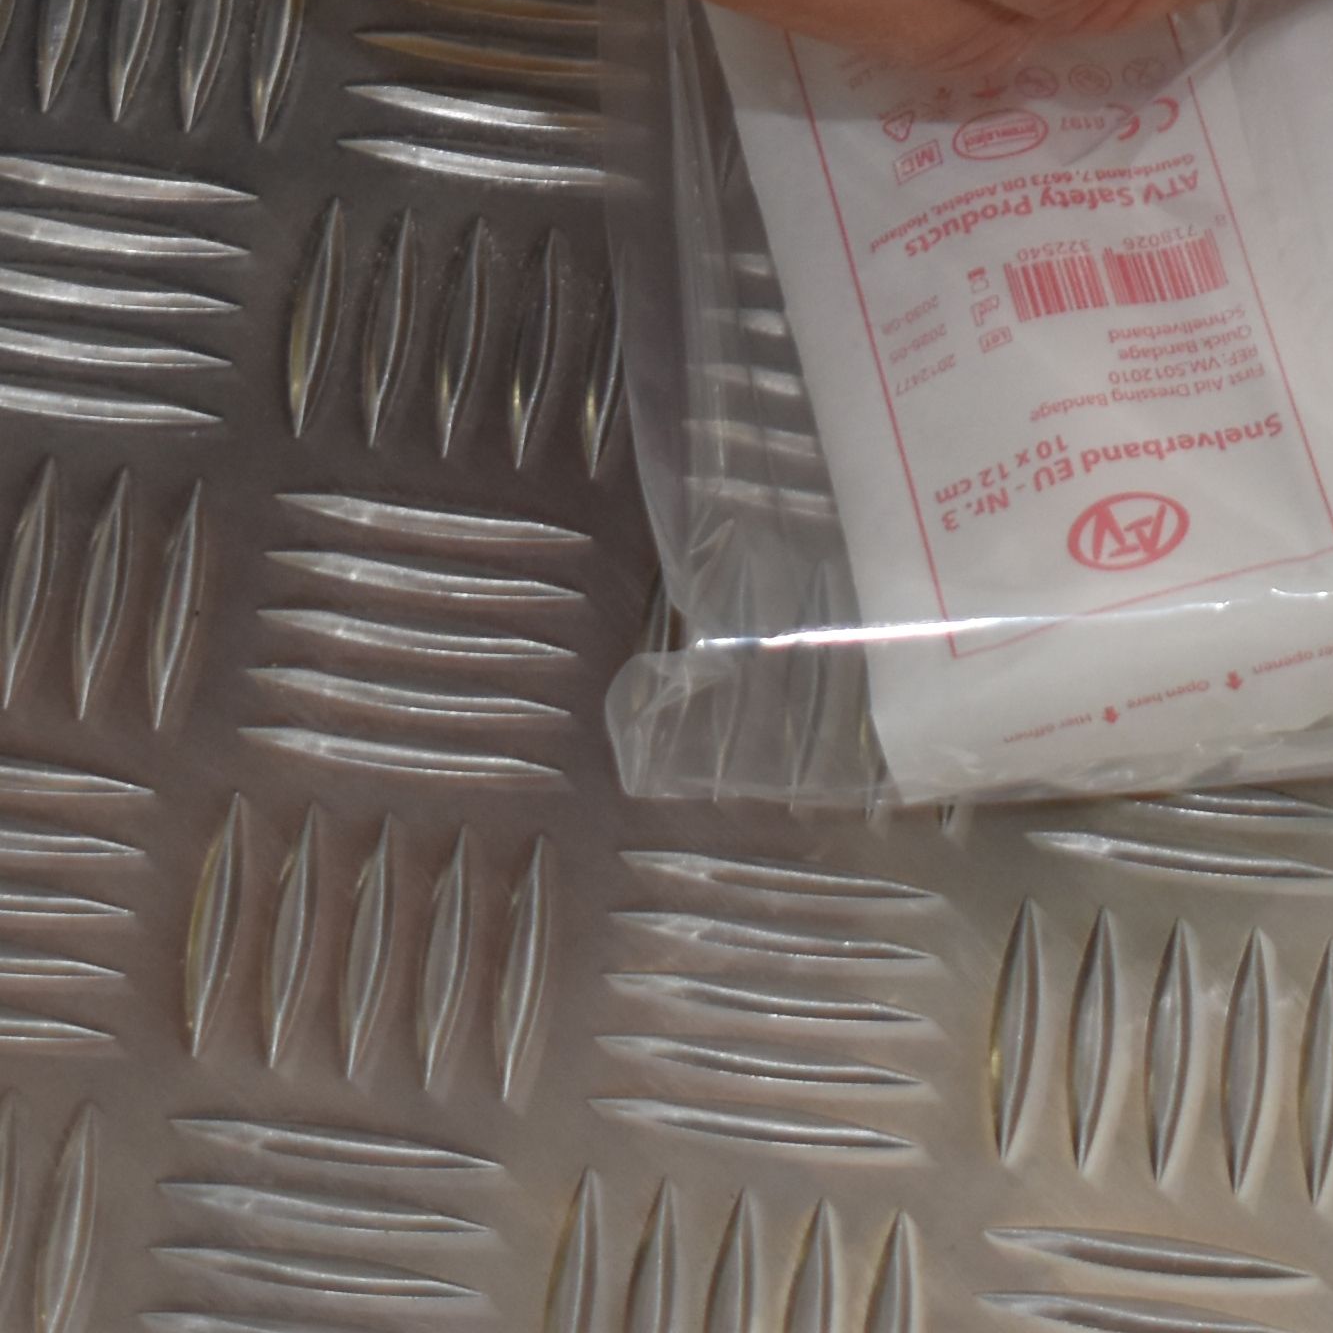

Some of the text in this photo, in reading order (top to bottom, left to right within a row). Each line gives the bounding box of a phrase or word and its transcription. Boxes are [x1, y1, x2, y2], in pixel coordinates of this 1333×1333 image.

[906, 169, 1198, 256] ATV Safety Products
[869, 213, 928, 254] Holland
[1016, 239, 1090, 262] 322540
[1118, 324, 1252, 360] Quick Bandage
[1030, 363, 1265, 422] First Aid Dressing Bandage
[1036, 435, 1067, 459] 10
[1081, 414, 1281, 471] Snelverband
[979, 463, 1009, 488] 12
[1033, 458, 1073, 492] EU
[935, 479, 972, 504] cm
[965, 490, 1008, 516] Nr.
[942, 509, 960, 531] 3
[1085, 496, 1172, 565] ATV
[1252, 651, 1314, 675] openen
[1127, 693, 1163, 710] here
[1165, 681, 1210, 698] Open
